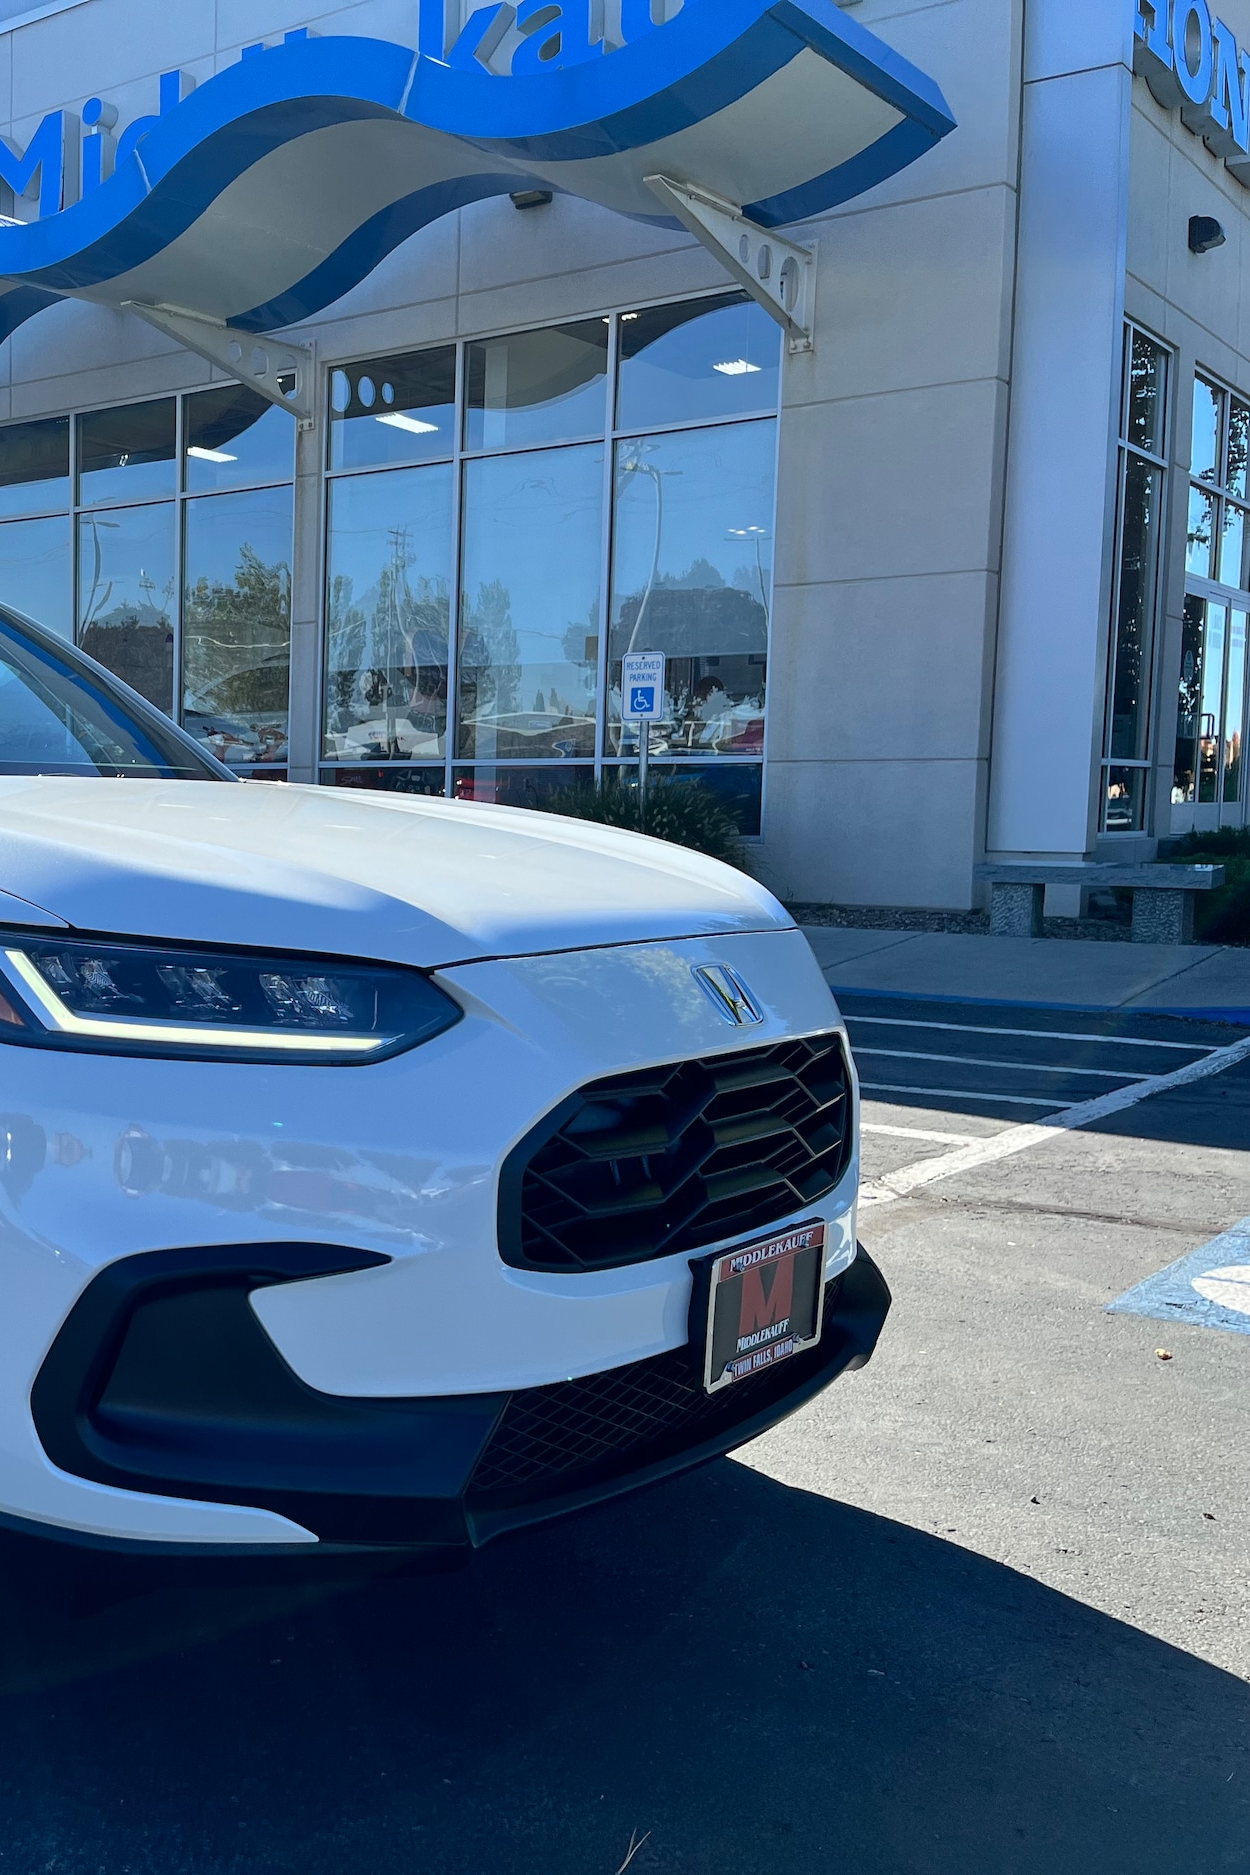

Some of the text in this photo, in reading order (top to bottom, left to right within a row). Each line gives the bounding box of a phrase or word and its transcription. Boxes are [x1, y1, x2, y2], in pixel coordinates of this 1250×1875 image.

[626, 661, 660, 670] RESERVED
[630, 672, 657, 682] PARKING
[730, 1231, 814, 1273] MIDDLEKAUFF
[736, 1318, 790, 1353] MIDDLEKAUFF
[733, 1338, 793, 1377] TWIN FALLS, IDAHO
